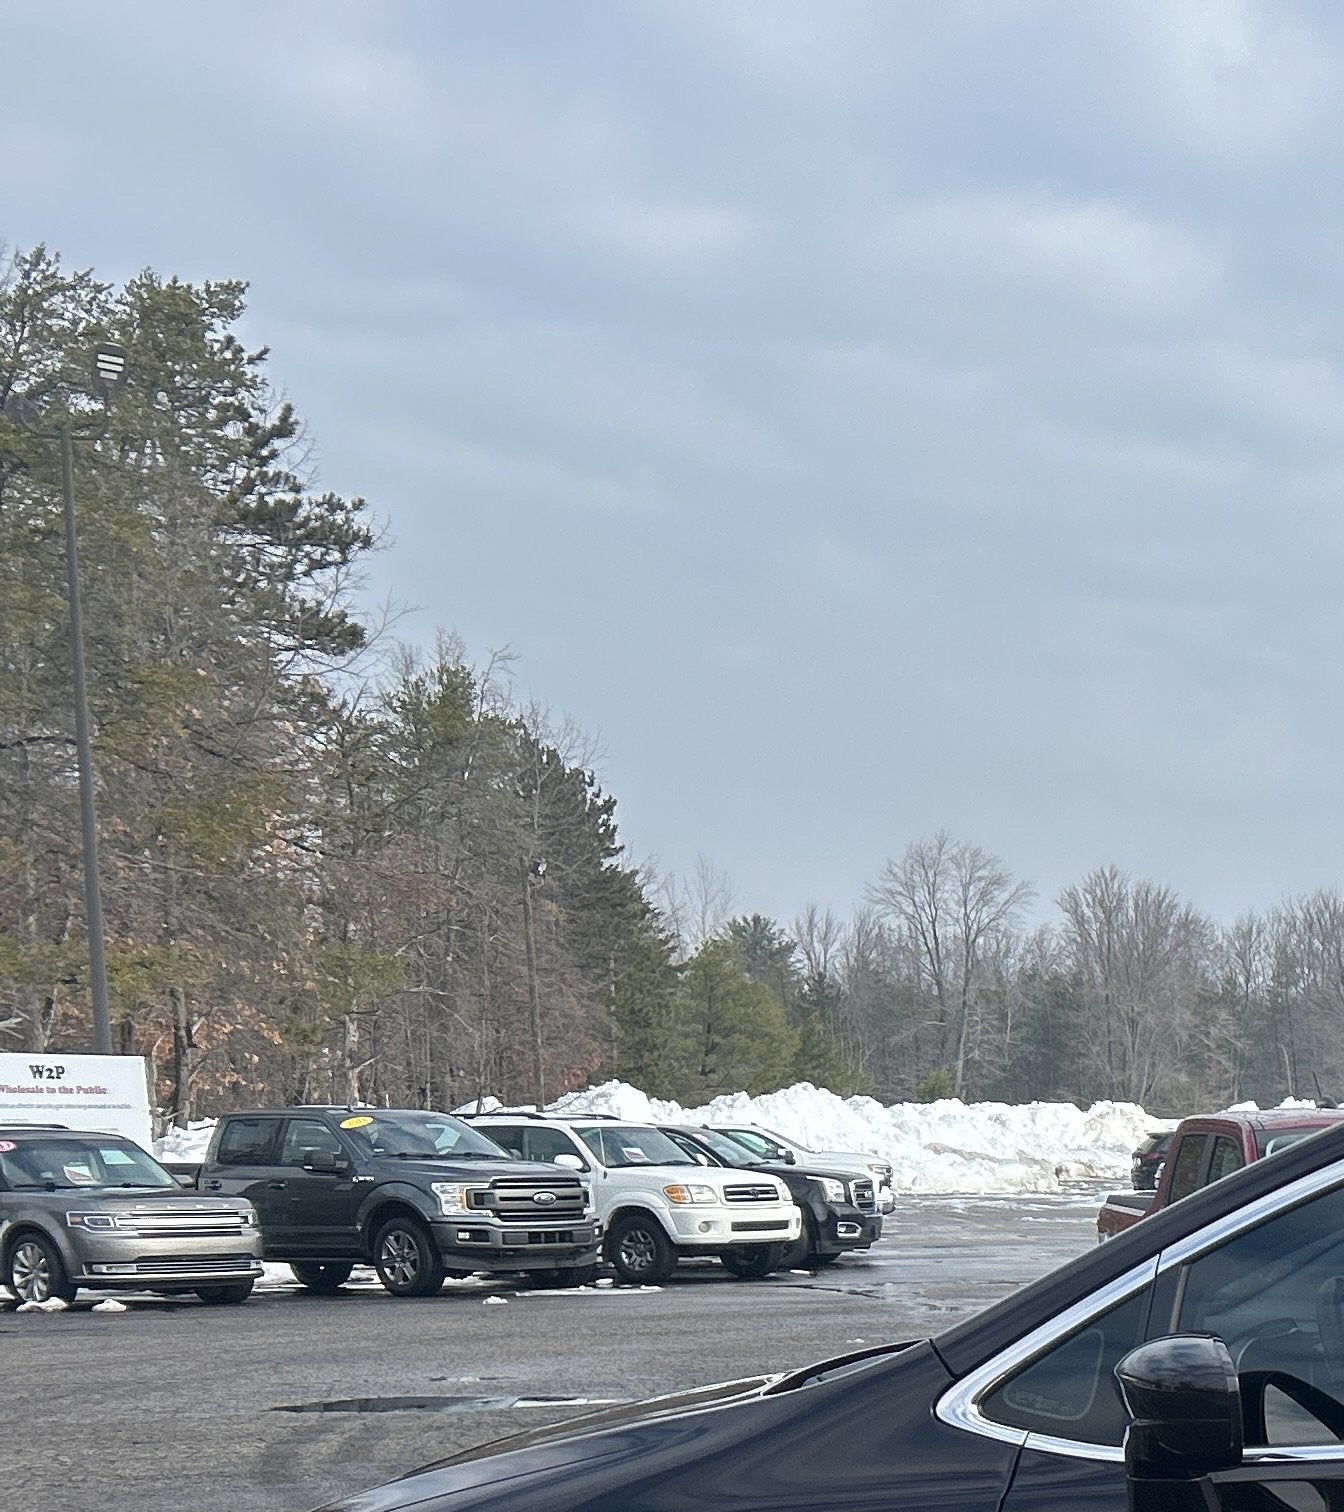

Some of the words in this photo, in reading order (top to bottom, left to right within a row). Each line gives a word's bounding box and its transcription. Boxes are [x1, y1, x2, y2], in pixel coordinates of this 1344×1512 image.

[29, 1065, 65, 1079] W2P
[46, 1086, 56, 1094] to
[58, 1086, 73, 1094] the
[76, 1086, 107, 1095] Public
